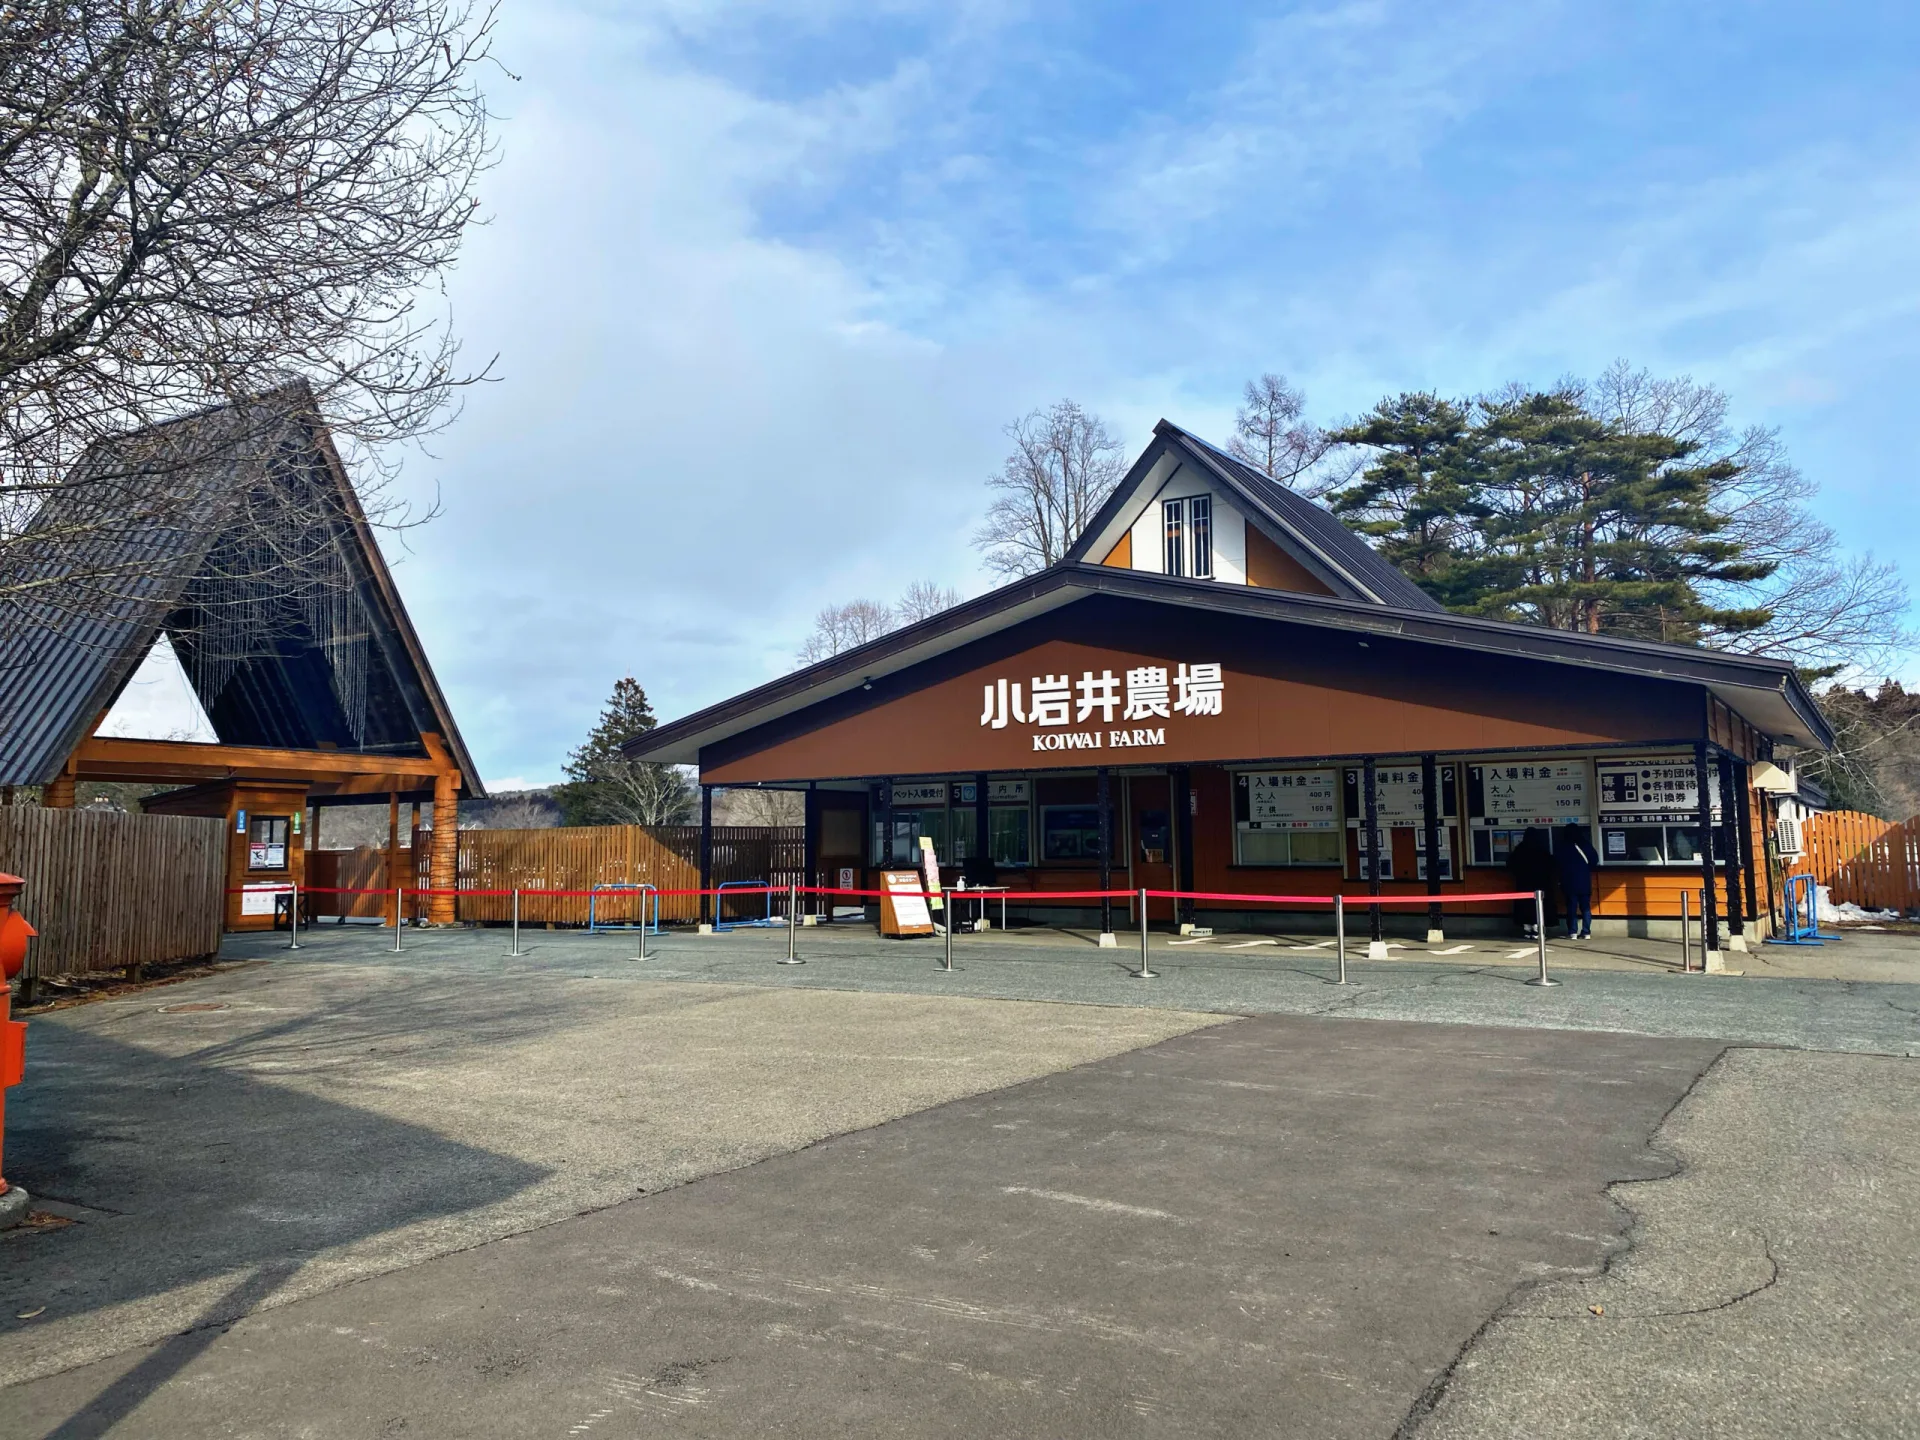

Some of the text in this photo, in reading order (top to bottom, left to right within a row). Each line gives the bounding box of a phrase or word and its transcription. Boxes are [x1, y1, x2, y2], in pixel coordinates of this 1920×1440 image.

[981, 663, 1225, 729] 小岩井農場
[1032, 728, 1166, 751] KOIWAI FARM
[1346, 773, 1356, 785] 3
[1378, 771, 1419, 784] 場料金
[1443, 769, 1453, 782] 2
[1473, 768, 1480, 780] 1
[1490, 767, 1552, 780] 入場料金
[1653, 769, 1718, 778] 予約団体付
[1239, 777, 1248, 788] 4
[1255, 775, 1307, 788] 入場料金
[1602, 775, 1636, 787] 専用
[954, 788, 961, 799] 5
[1491, 785, 1515, 794] 大人
[1255, 792, 1276, 801] 大人
[1603, 790, 1637, 802] 窓口
[1653, 793, 1686, 803] 引換券
[1256, 805, 1276, 814] 子供
[1491, 800, 1515, 809] 子供
